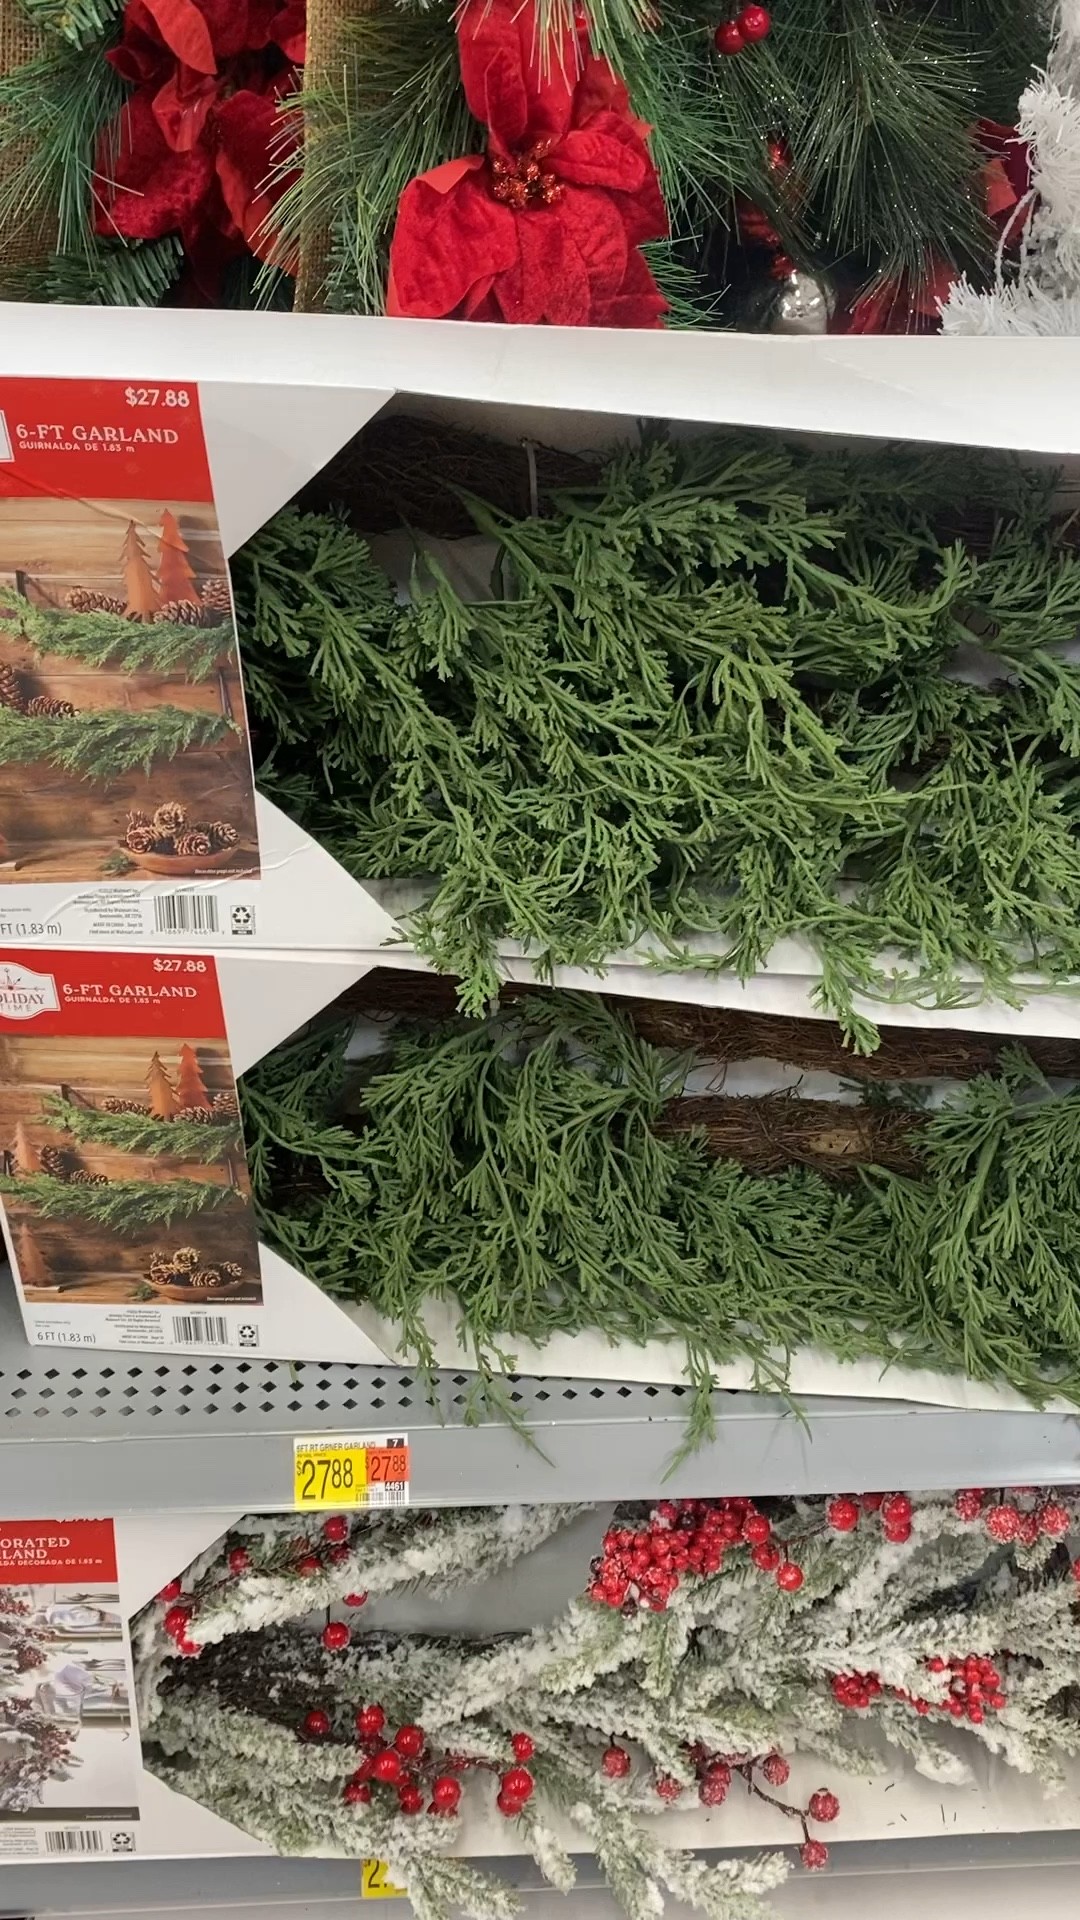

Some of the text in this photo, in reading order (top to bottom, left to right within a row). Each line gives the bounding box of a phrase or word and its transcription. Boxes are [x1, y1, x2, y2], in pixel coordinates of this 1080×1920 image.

[124, 386, 190, 408] $27.88
[16, 423, 179, 444] 6-FT GARLAND
[19, 440, 80, 451] GUIRNALDA
[84, 442, 98, 452] DE
[125, 445, 135, 453] m
[0, 921, 62, 937] FT (1.83 m)
[153, 957, 207, 973] $27.88
[62, 983, 197, 998] 6-FT GARLAND
[0, 992, 45, 1005] LIDAY
[37, 1331, 96, 1344] 6 FT (1.83 m)
[392, 1439, 399, 1447] 7
[385, 1481, 404, 1491] 4461
[17, 1558, 63, 1566] DECORADA
